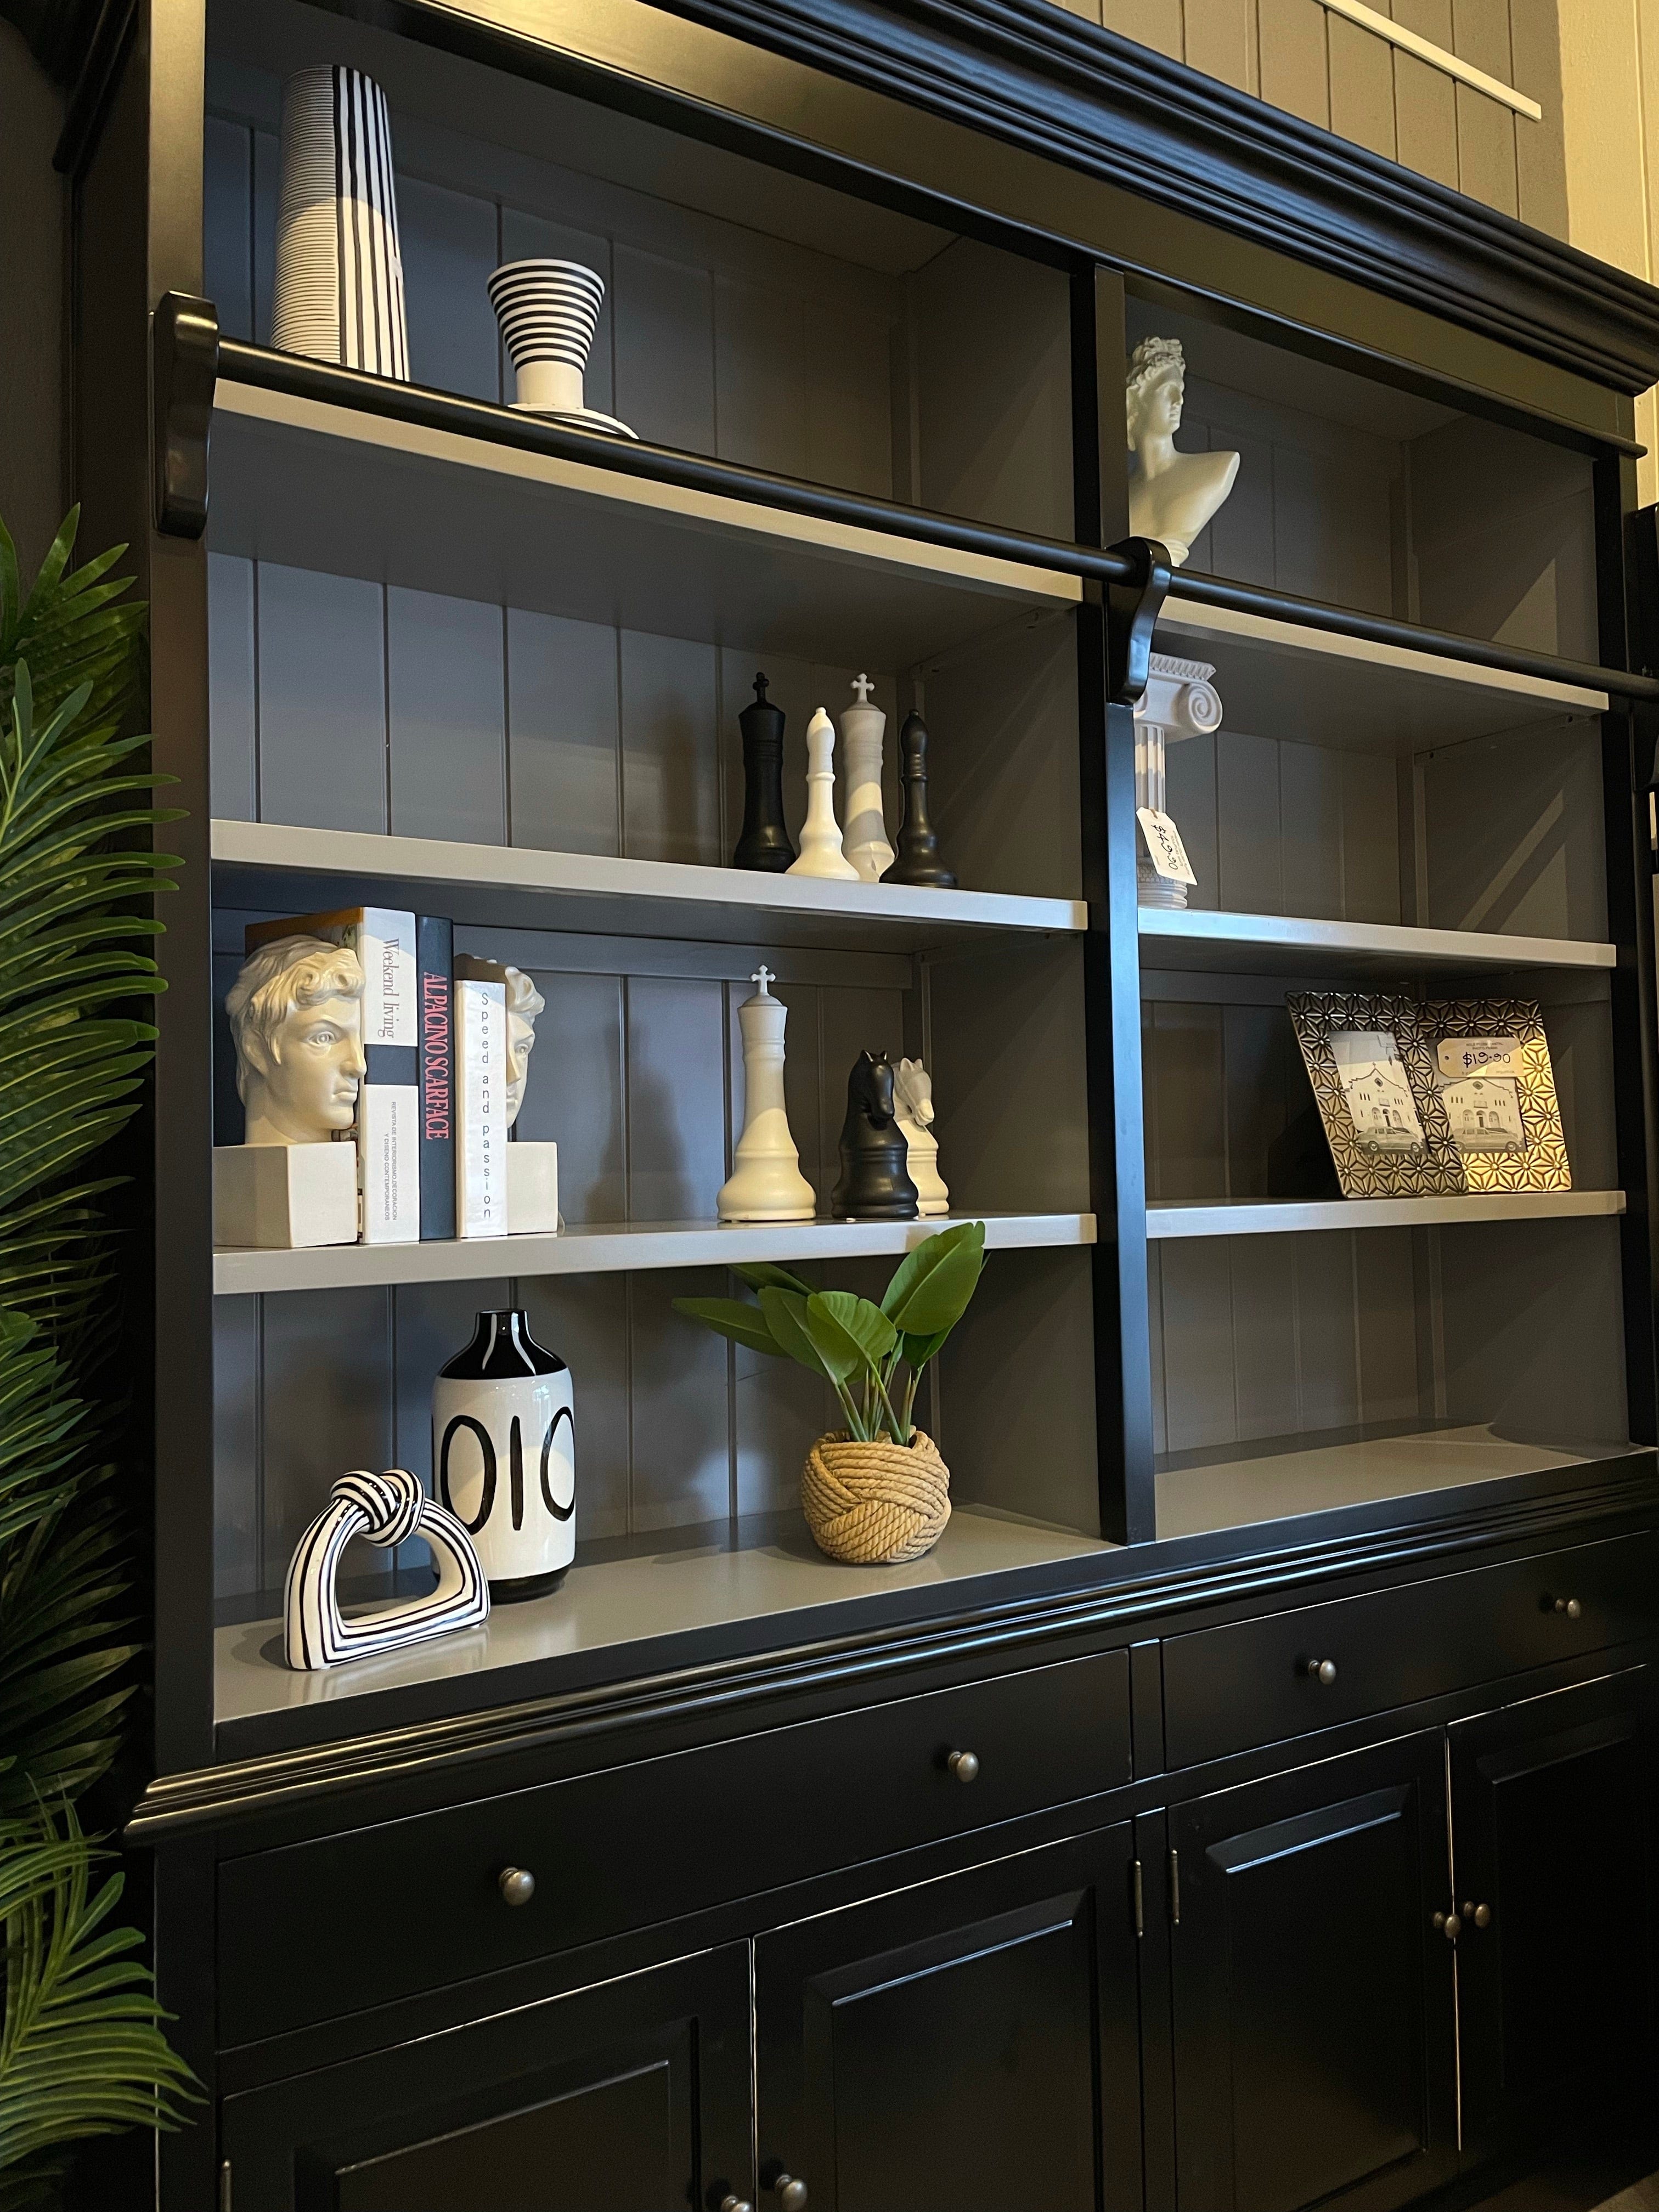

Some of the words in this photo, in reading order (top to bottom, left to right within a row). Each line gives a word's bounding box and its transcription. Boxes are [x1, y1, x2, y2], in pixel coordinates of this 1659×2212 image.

[383, 938, 399, 996] Weekend
[377, 1002, 400, 1038] living
[425, 1057, 449, 1140] SCARFACE
[391, 1127, 397, 1136] DE
